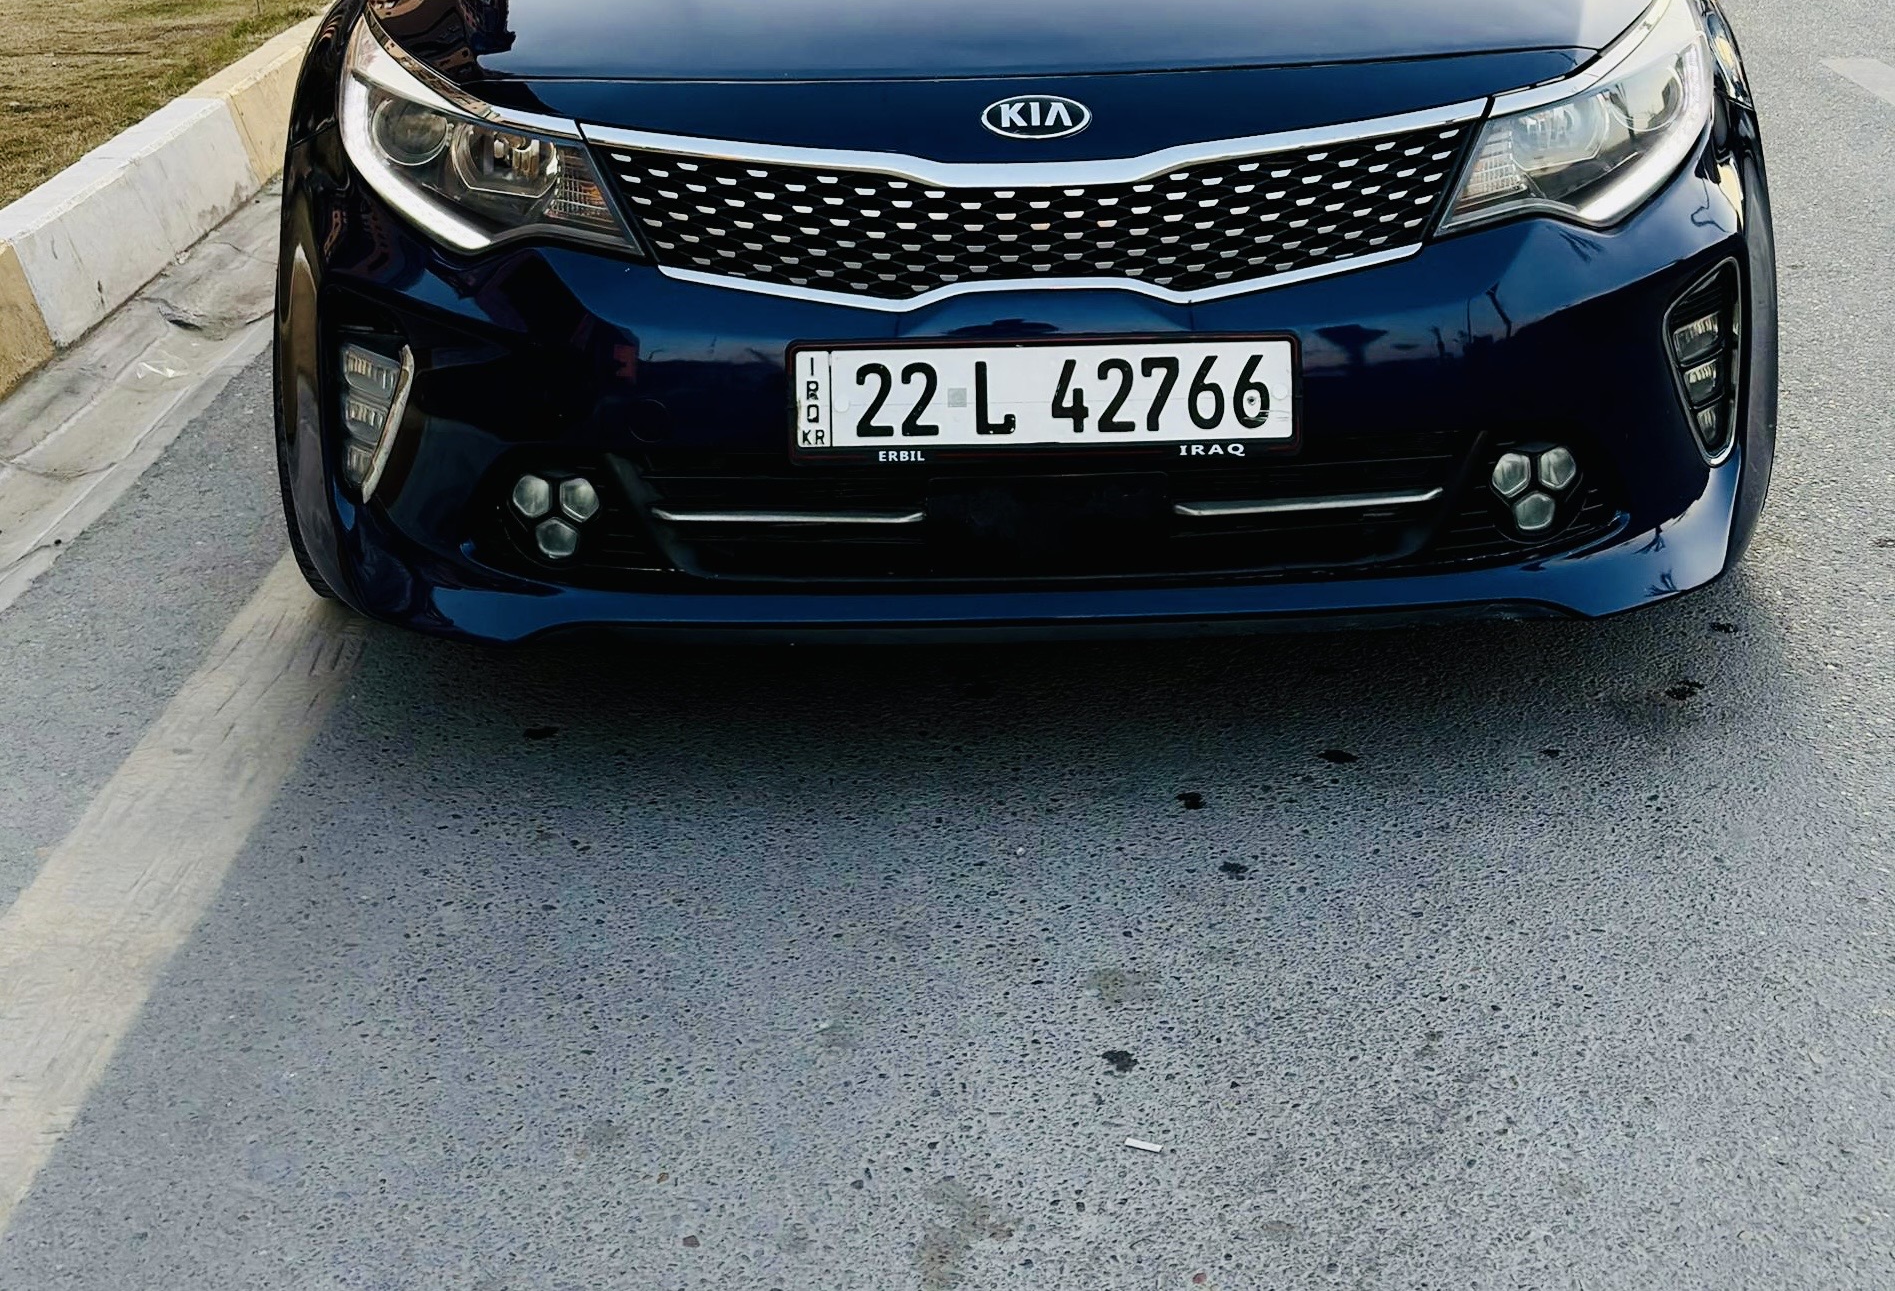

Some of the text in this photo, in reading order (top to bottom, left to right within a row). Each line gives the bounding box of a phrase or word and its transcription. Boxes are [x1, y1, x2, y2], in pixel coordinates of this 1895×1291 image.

[1000, 102, 1073, 127] KIA
[855, 354, 1270, 437] 22 L 42766
[802, 429, 825, 445] KR
[878, 450, 926, 463] ERBIL
[1179, 443, 1246, 457] IRAQ
